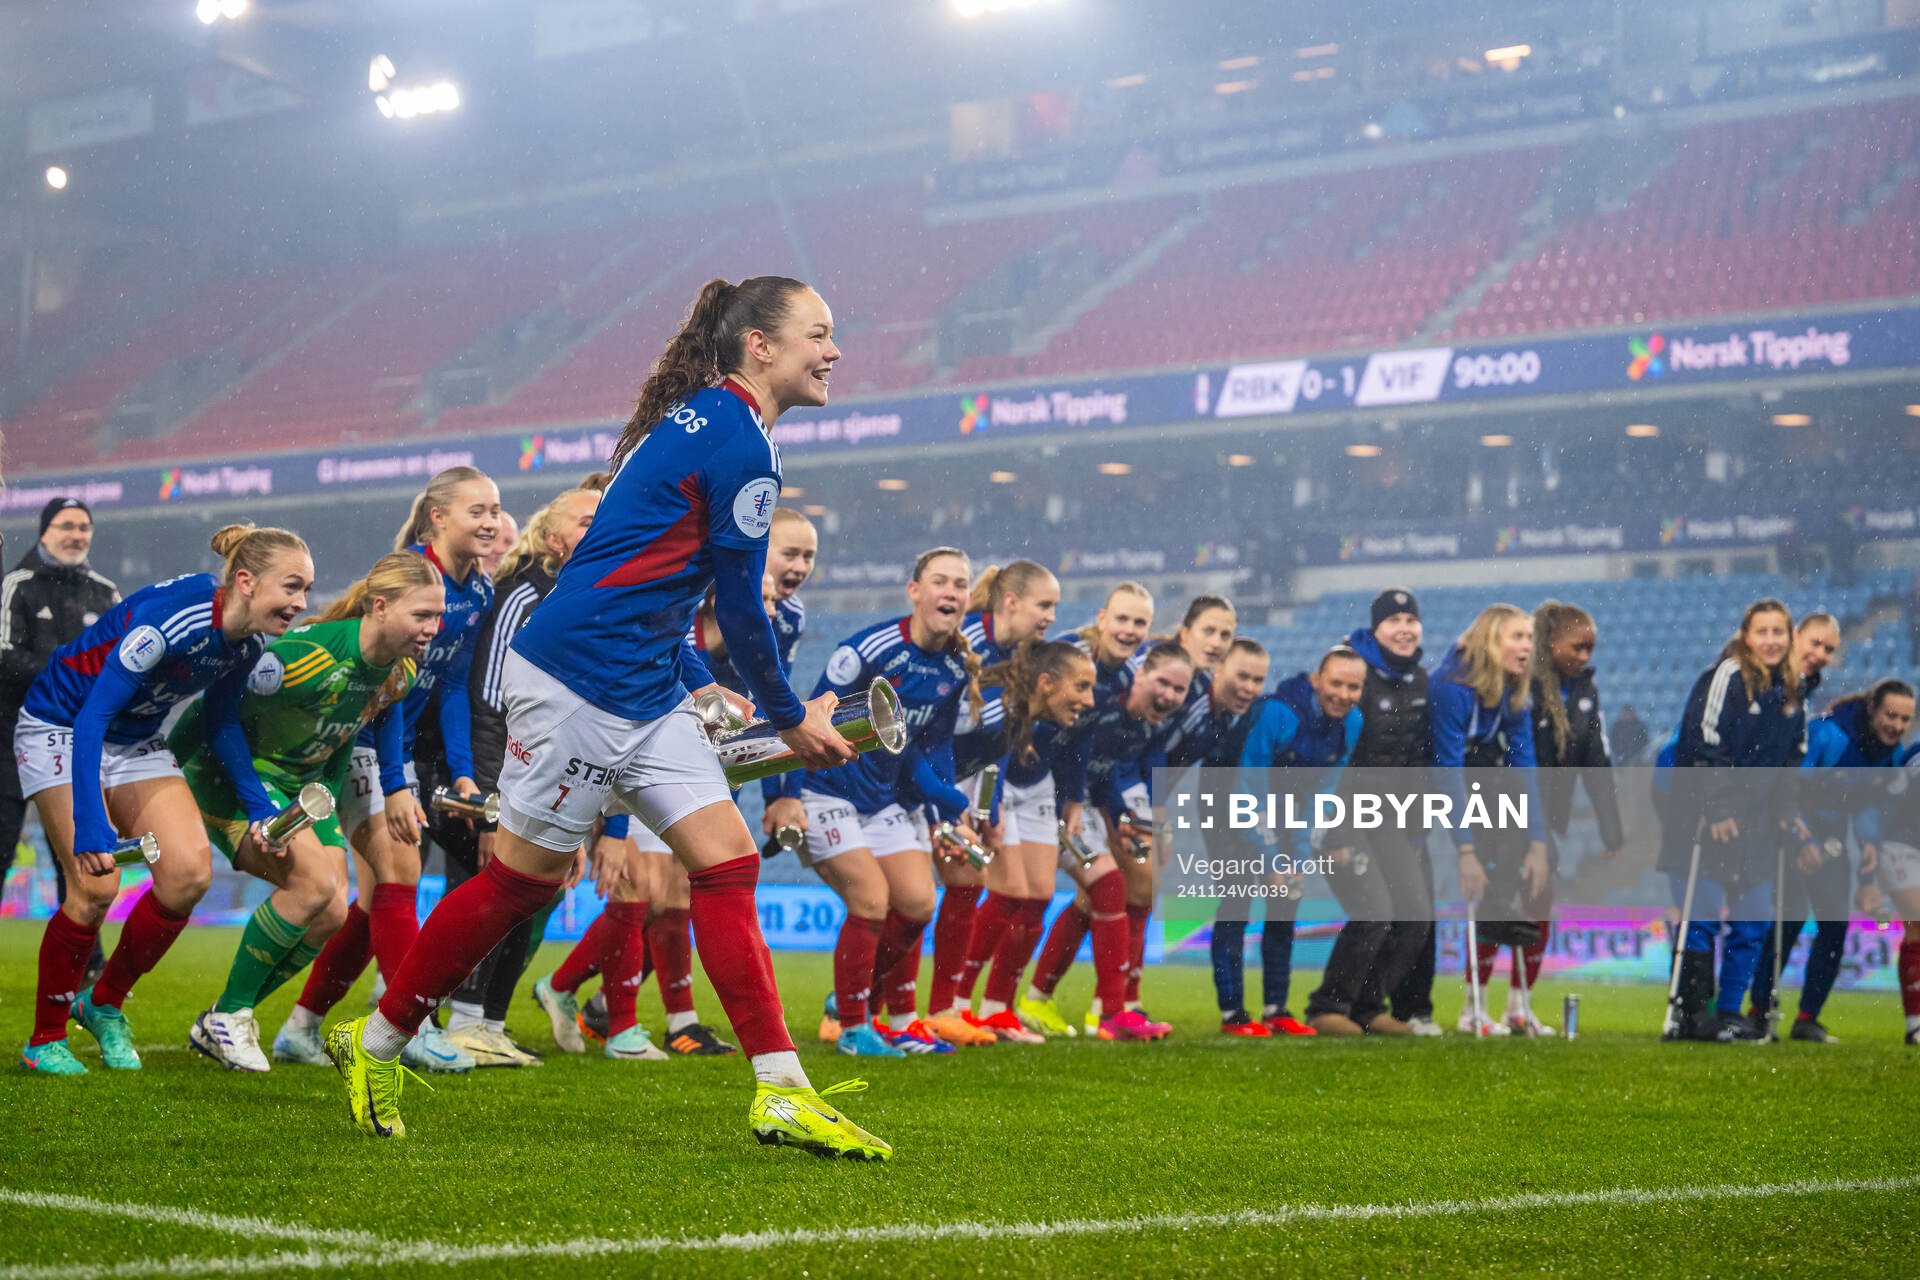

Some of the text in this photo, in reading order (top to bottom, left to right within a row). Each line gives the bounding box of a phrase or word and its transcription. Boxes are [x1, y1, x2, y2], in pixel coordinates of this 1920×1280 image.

[1671, 327, 1851, 370] Norsk Tipping
[1379, 362, 1423, 388] VIF
[1454, 351, 1541, 389] 90:00
[992, 389, 1128, 425] Norsk Tipping
[53, 755, 63, 775] 3
[352, 775, 373, 798] 22
[551, 783, 570, 811] 7
[824, 827, 841, 847] 19
